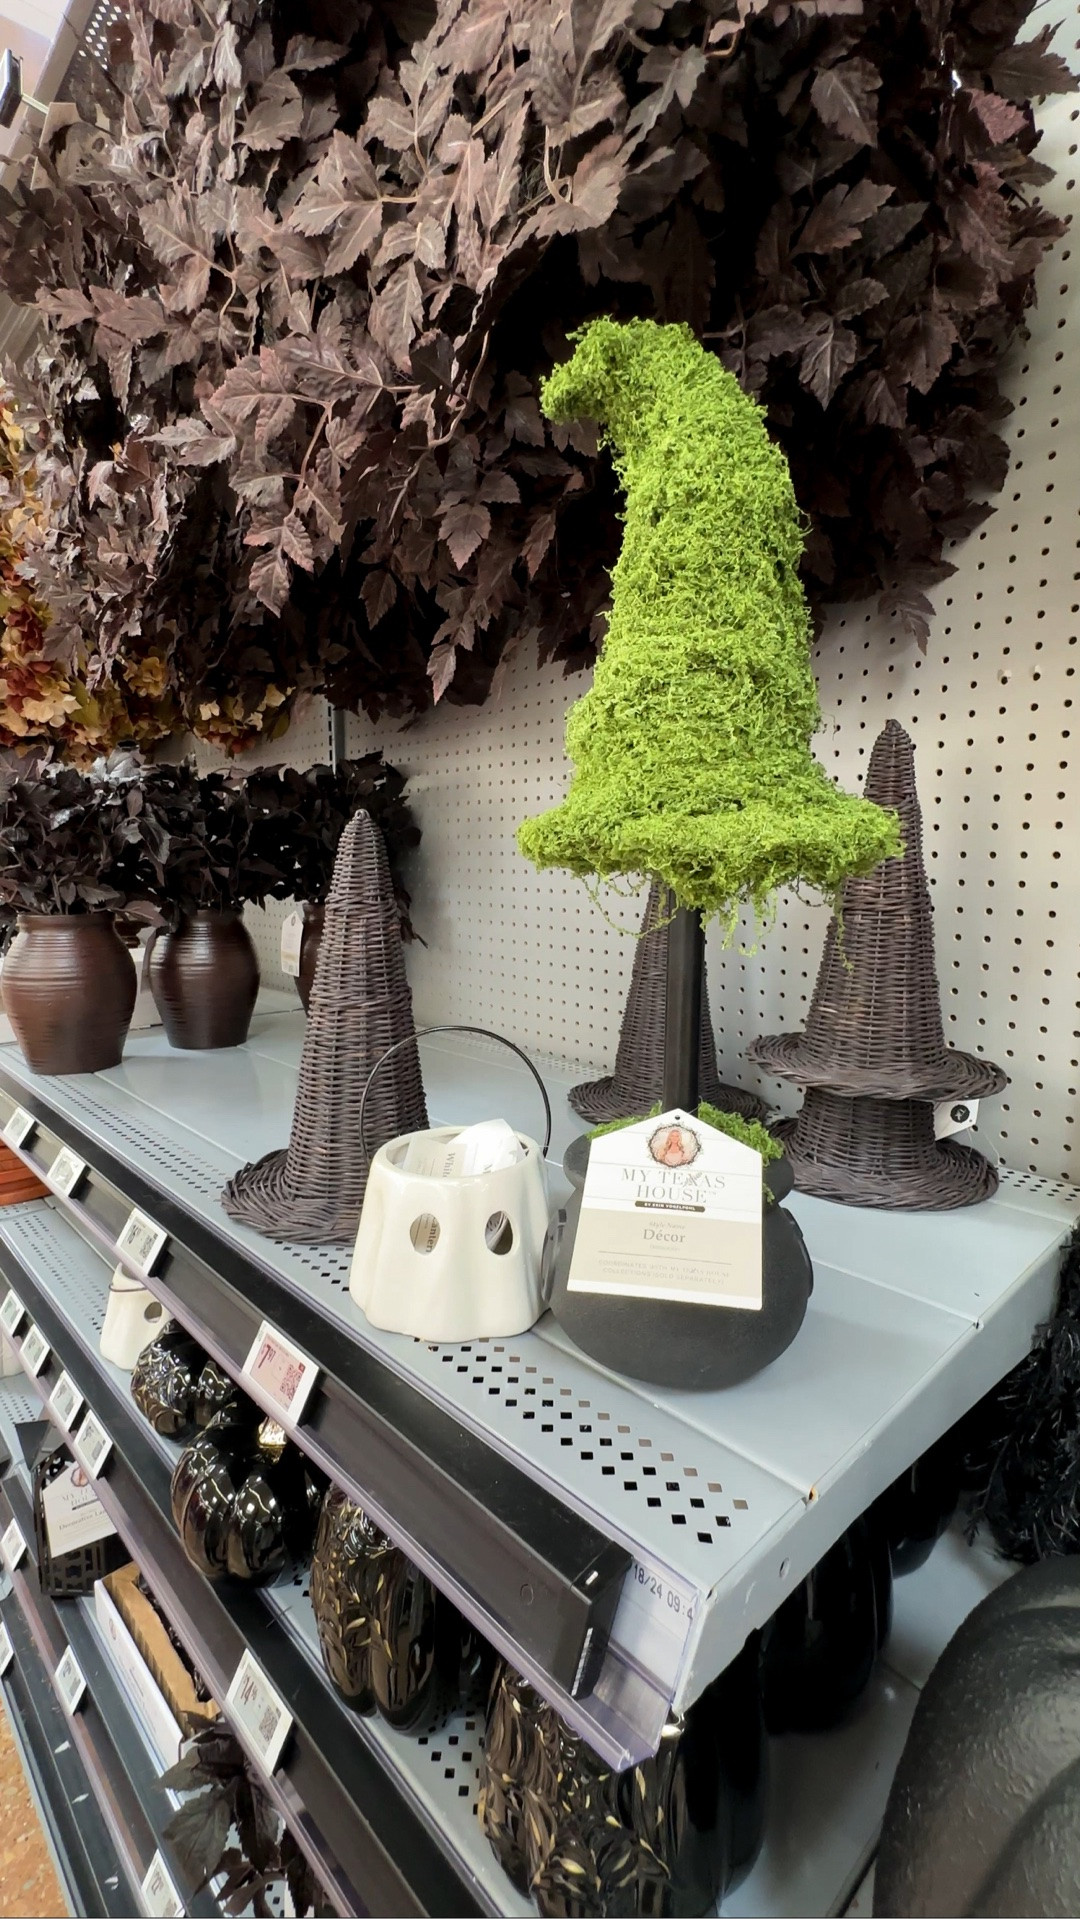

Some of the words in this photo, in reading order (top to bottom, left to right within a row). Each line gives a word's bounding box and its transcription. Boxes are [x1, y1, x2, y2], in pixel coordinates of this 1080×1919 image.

[621, 1168, 651, 1182] MY
[658, 1170, 726, 1189] TEXAS
[426, 1217, 438, 1253] antern
[643, 1229, 686, 1243] Décor
[633, 1563, 663, 1599] 18/24
